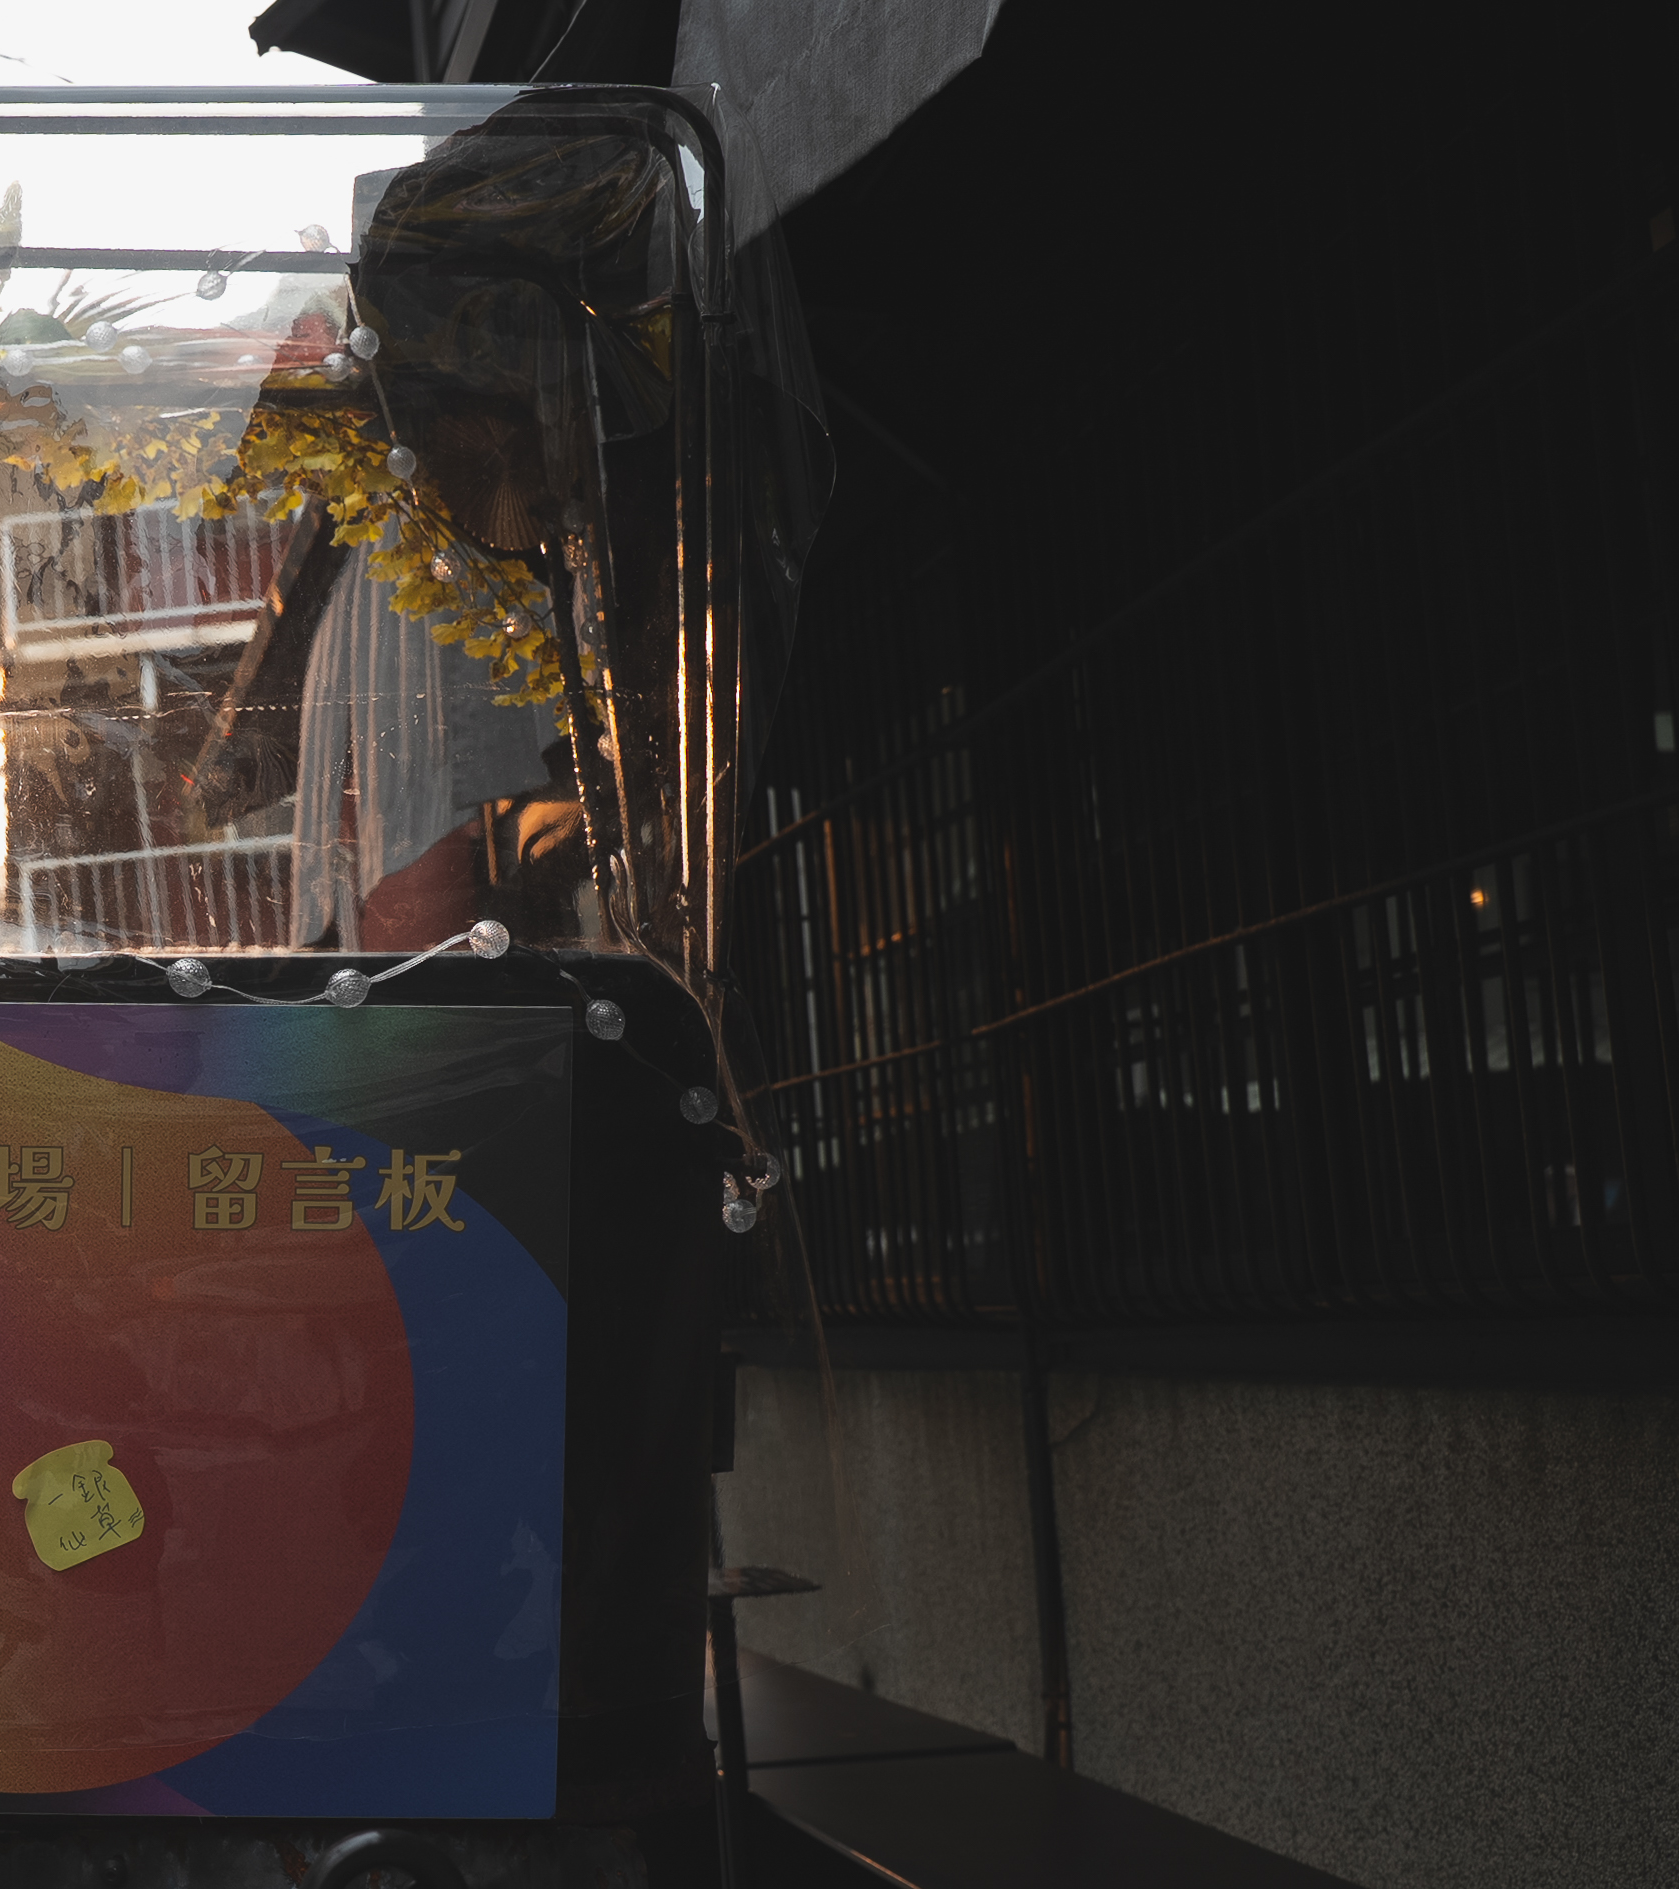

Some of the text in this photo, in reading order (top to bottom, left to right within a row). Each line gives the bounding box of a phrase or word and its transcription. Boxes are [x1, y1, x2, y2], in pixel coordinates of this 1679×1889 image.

[185, 1143, 466, 1233] 留言板
[59, 1502, 122, 1551] 仙草
